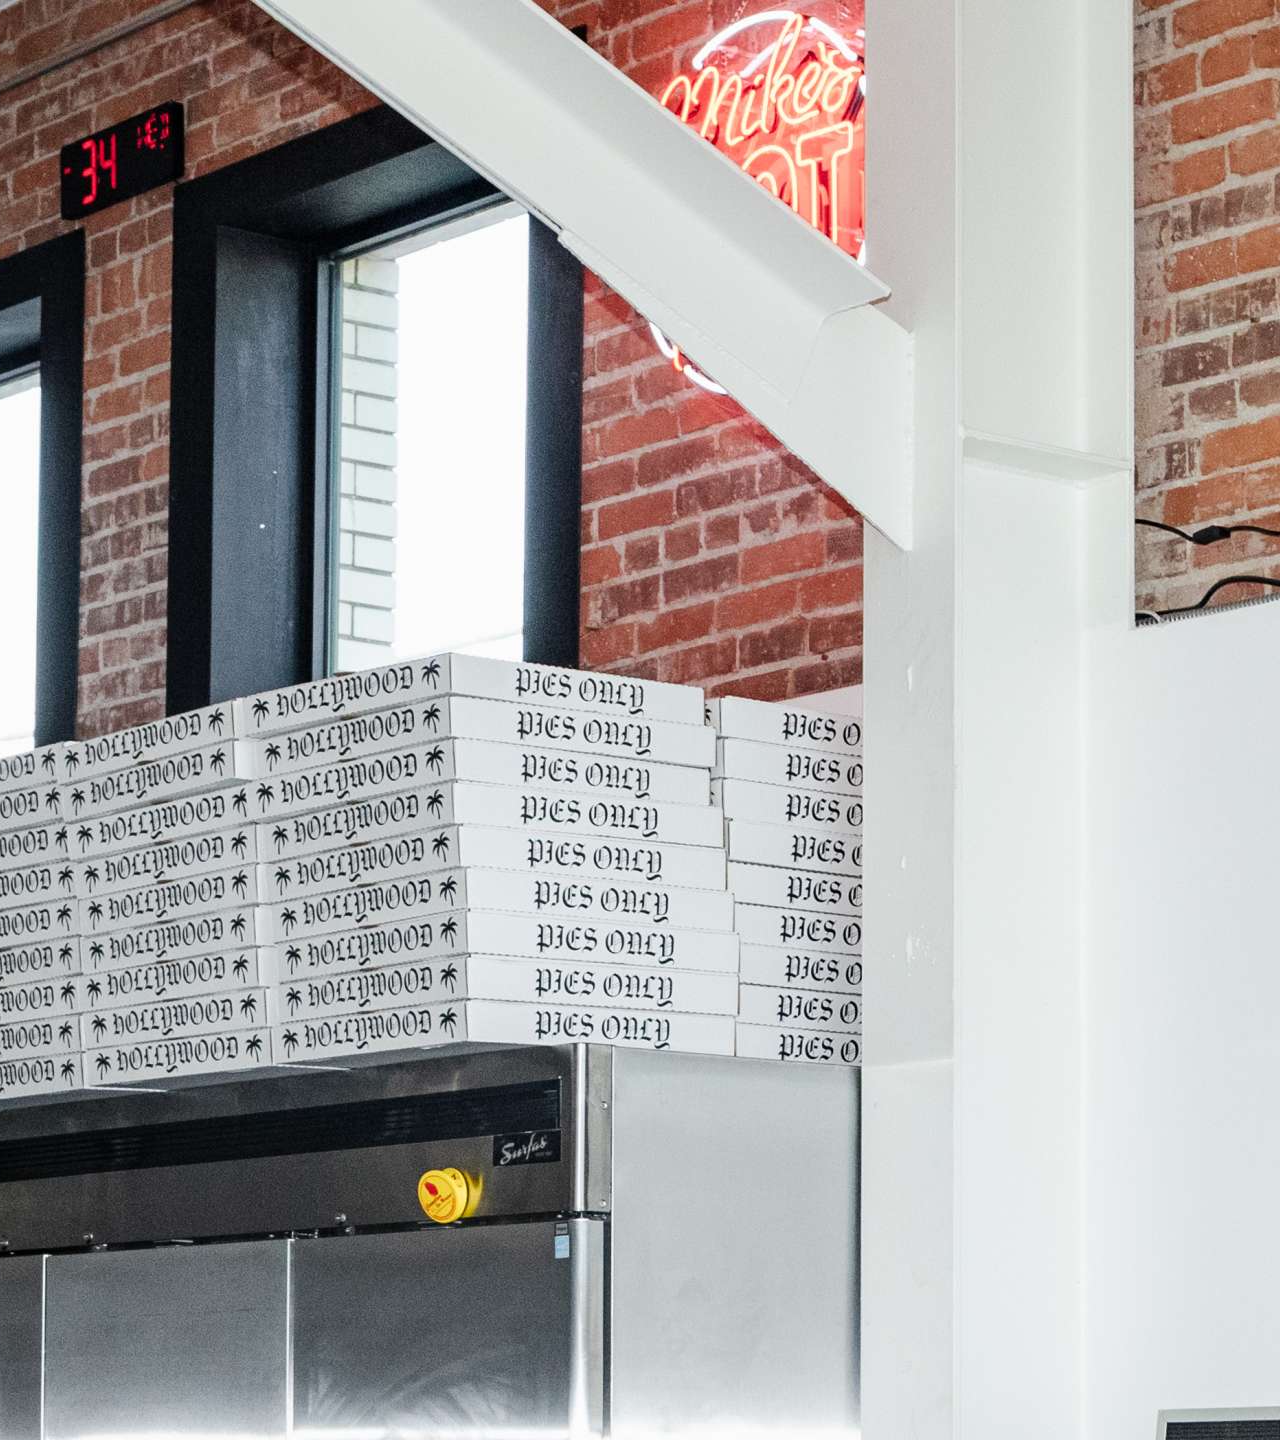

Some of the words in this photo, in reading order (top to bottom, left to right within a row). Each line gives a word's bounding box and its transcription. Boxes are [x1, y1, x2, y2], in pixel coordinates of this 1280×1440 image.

[82, 133, 117, 206] 34
[514, 667, 572, 699] PIES
[578, 677, 644, 716] ONLY
[516, 710, 576, 741] PIES
[582, 719, 652, 756] ONLY
[781, 712, 837, 743] PIES
[520, 749, 579, 784] PIES
[585, 762, 650, 800] ONLY
[785, 753, 841, 784] PIES
[520, 795, 582, 825] PIES
[588, 802, 659, 838] ONLY
[785, 789, 841, 824] PIES
[527, 838, 586, 868] PIES
[592, 845, 663, 881] ONLY
[790, 834, 846, 864] PIES
[533, 880, 593, 910] PIES
[600, 887, 669, 924] ONLY
[786, 875, 843, 905] PIES
[536, 923, 598, 953] PIES
[605, 929, 675, 965] ONLY
[779, 914, 837, 944] PIES
[784, 954, 840, 983] PIES
[534, 968, 596, 998] PIES
[602, 972, 673, 1012] ONLY
[776, 994, 834, 1022] PIES
[535, 1010, 594, 1040] PIES
[601, 1015, 670, 1050] ONLY
[778, 1033, 835, 1062] PIES
